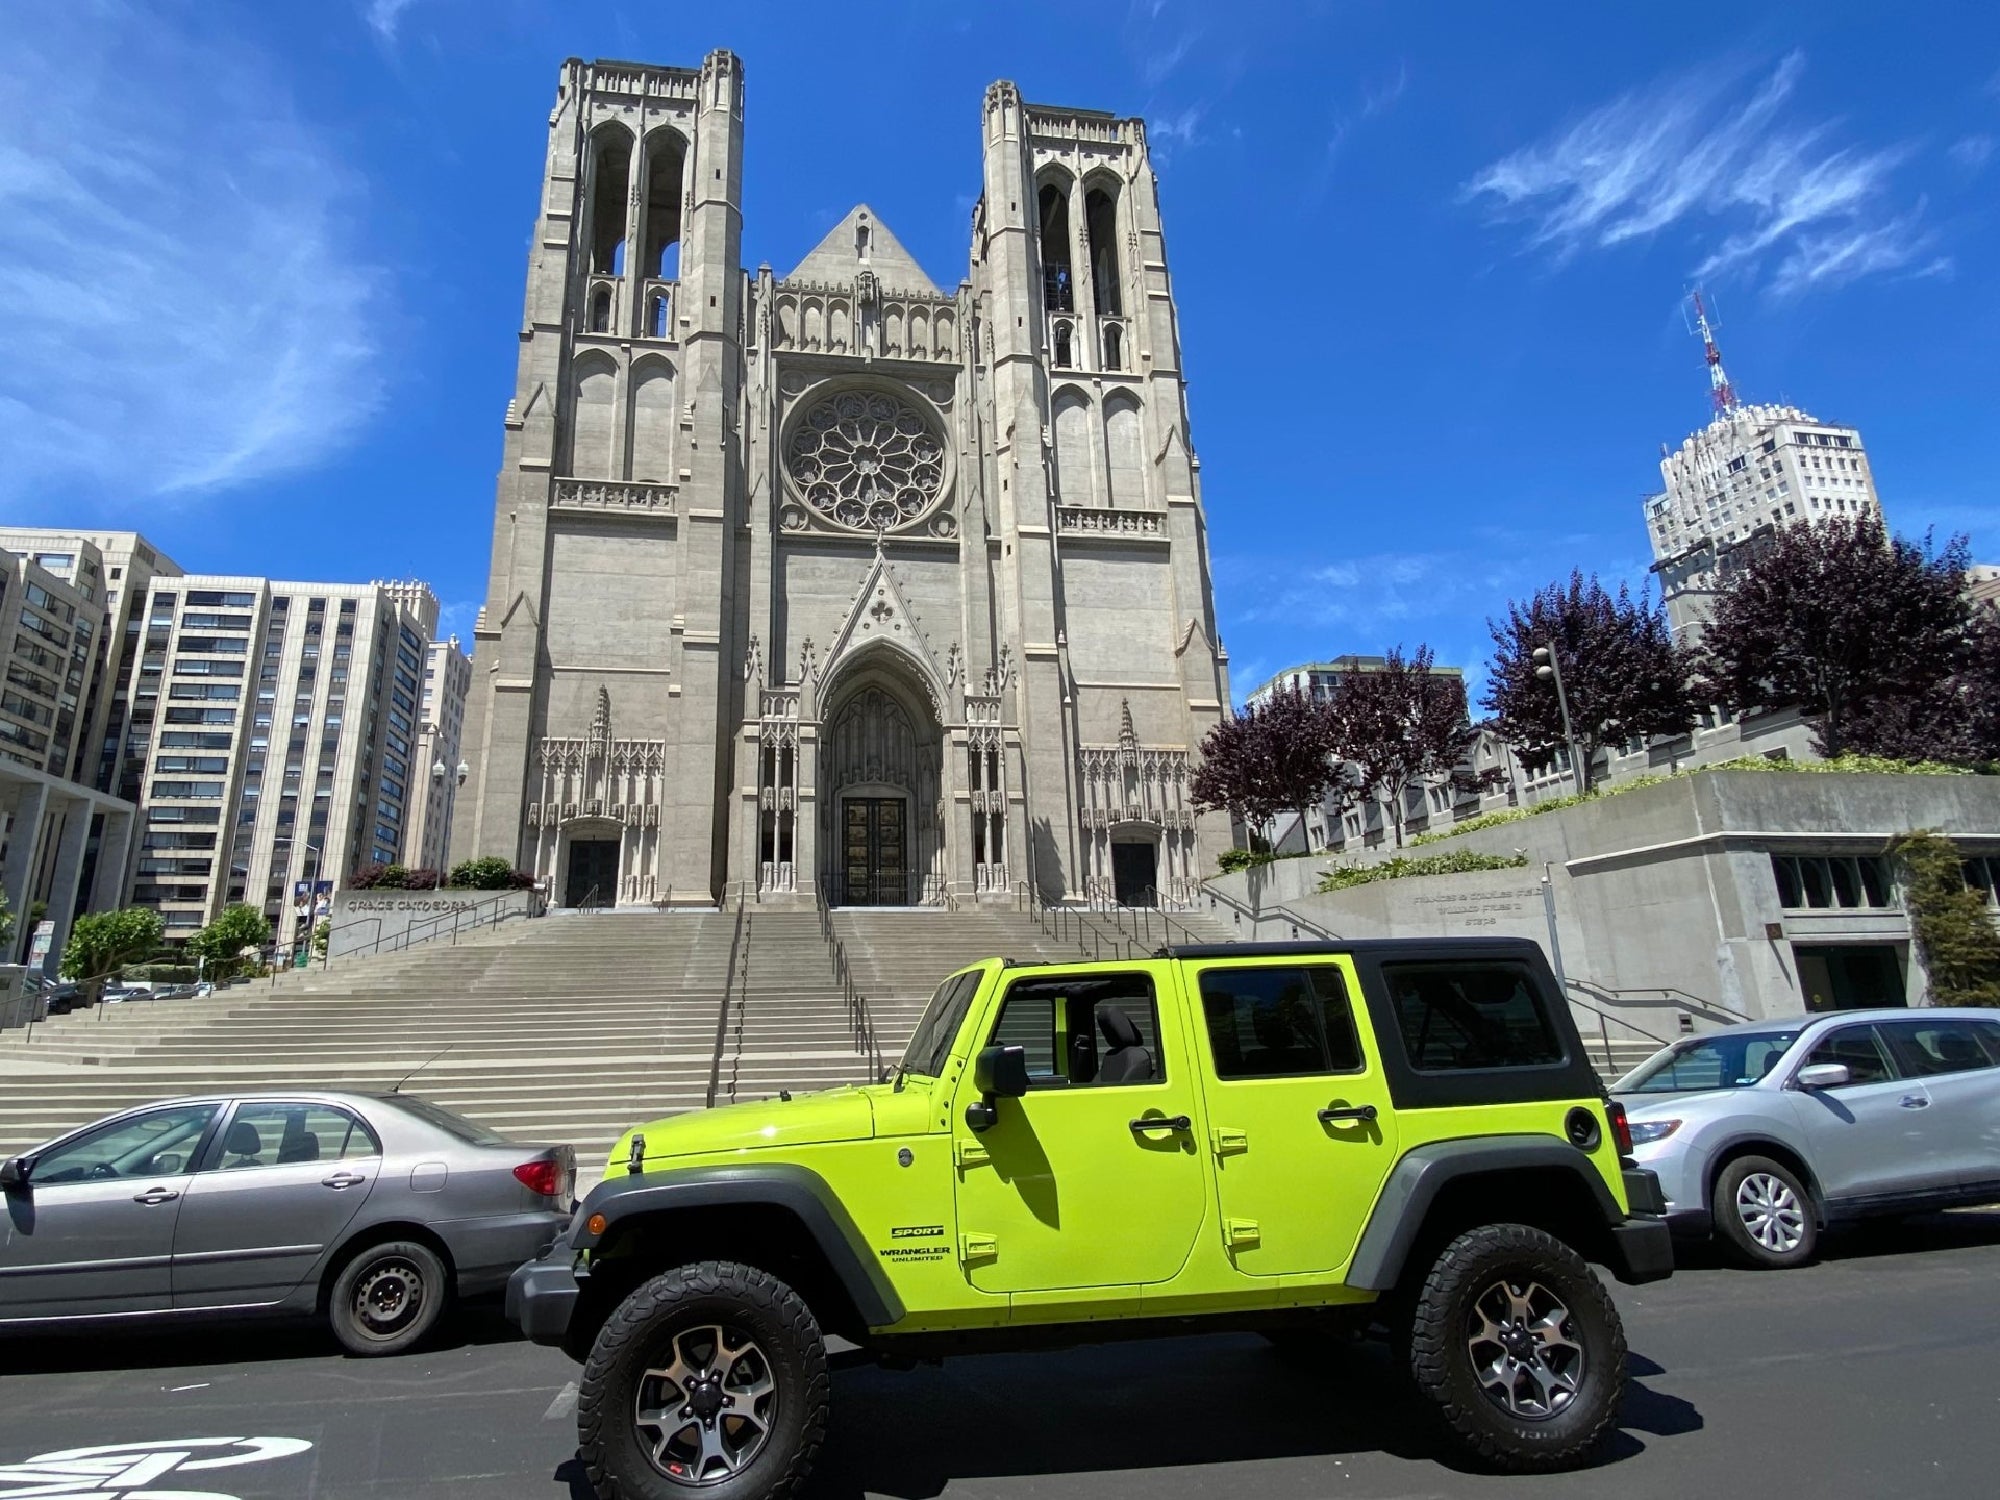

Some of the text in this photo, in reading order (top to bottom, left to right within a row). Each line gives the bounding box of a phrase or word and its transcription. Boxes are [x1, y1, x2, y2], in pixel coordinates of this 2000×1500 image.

[348, 900, 394, 913] GRACE
[893, 1227, 943, 1237] SPORT
[880, 1247, 951, 1256] WRANGLER
